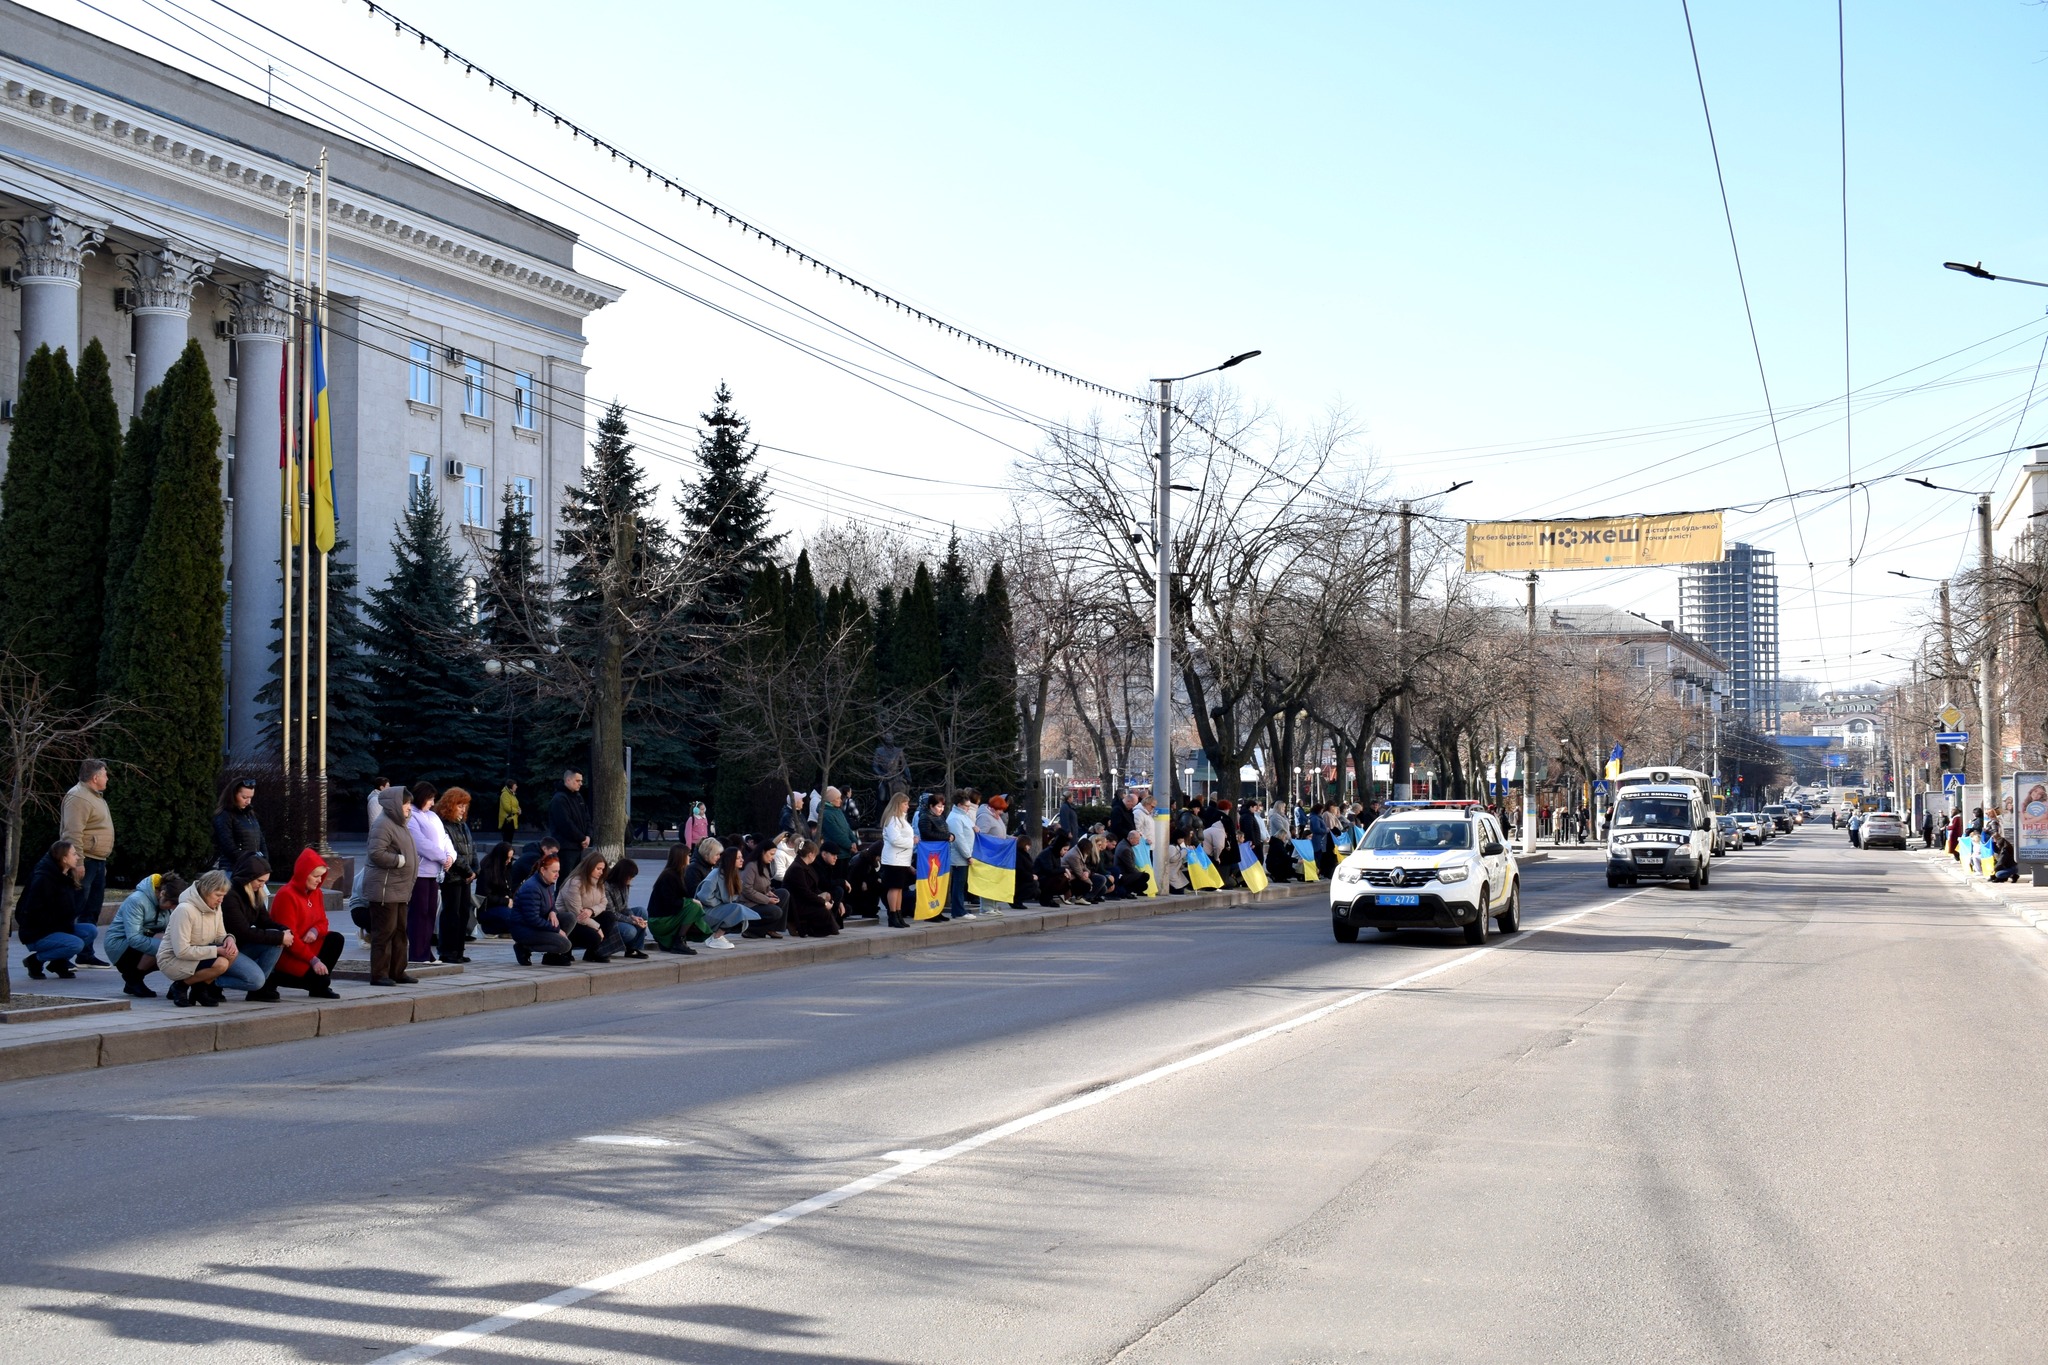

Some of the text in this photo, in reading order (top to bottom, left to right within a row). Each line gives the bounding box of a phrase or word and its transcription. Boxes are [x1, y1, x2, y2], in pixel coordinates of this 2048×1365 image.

[1681, 523, 1718, 532] будь-якої
[2022, 823, 2048, 831] ІНТЕ
[1642, 833, 1685, 844] ЩИТІ
[1395, 896, 1415, 904] 4772
